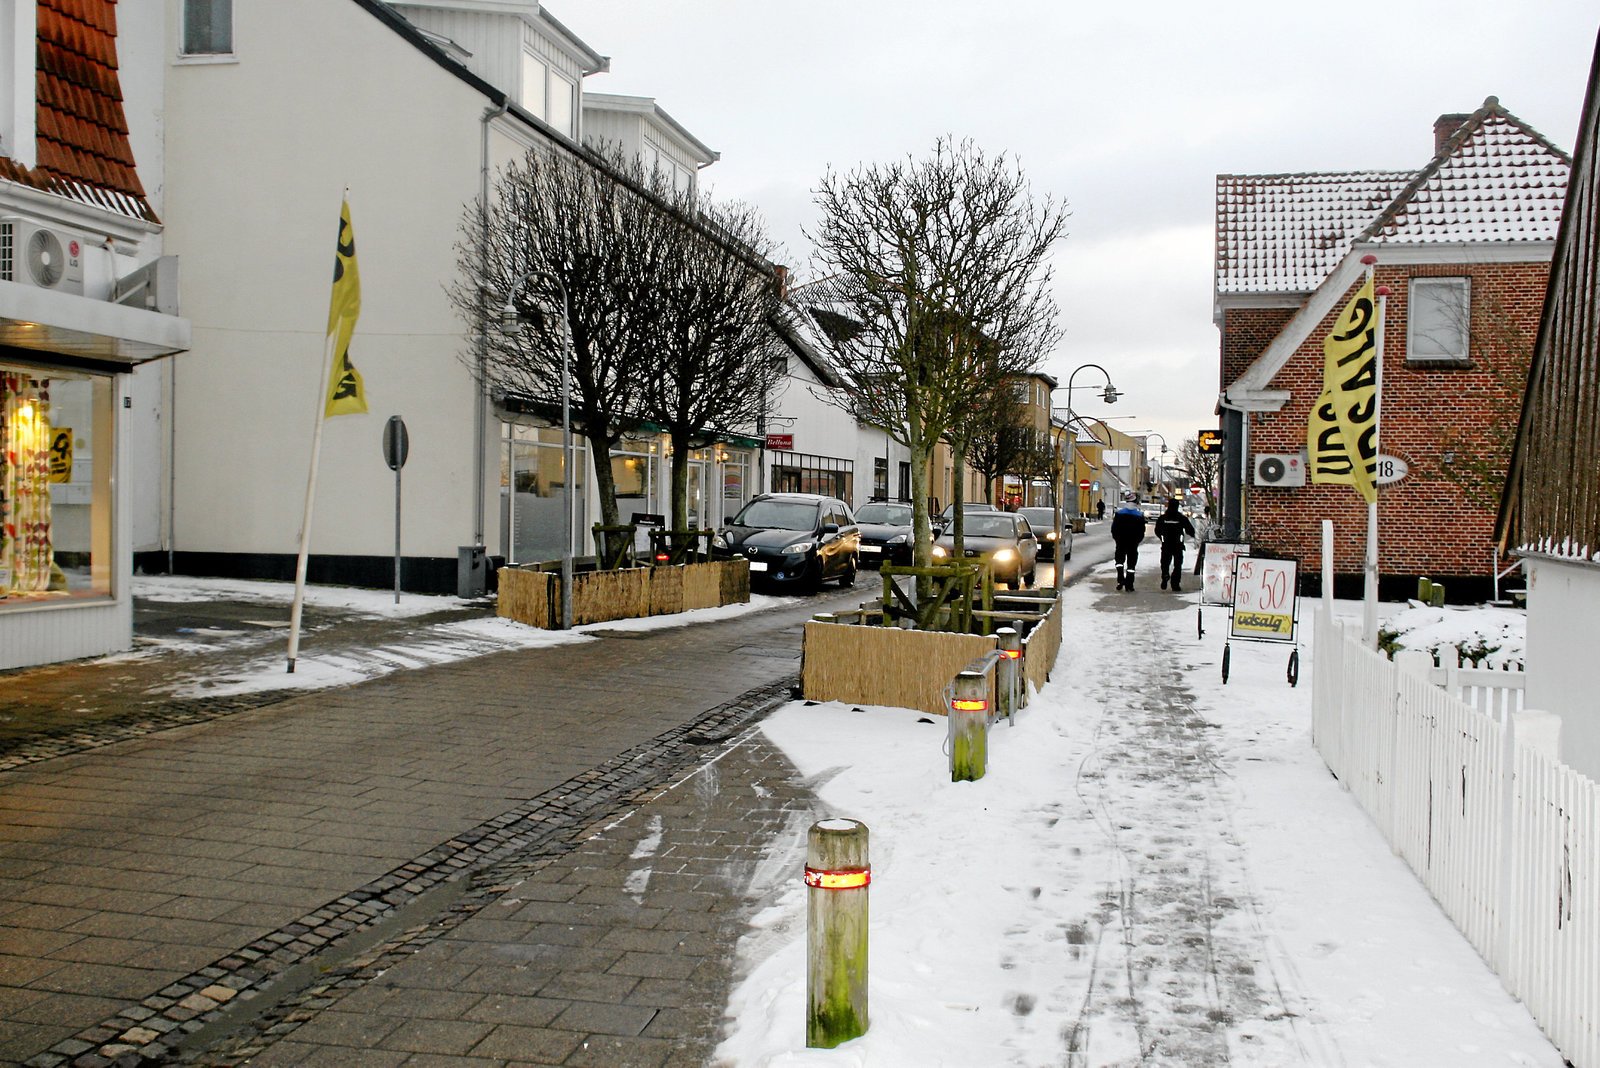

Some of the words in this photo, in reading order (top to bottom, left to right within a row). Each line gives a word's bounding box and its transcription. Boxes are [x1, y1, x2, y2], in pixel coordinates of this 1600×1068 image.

[69, 259, 79, 267] LG
[1332, 298, 1377, 488] DSALG
[1378, 461, 1394, 477] 18
[1237, 613, 1283, 632] udsalg
